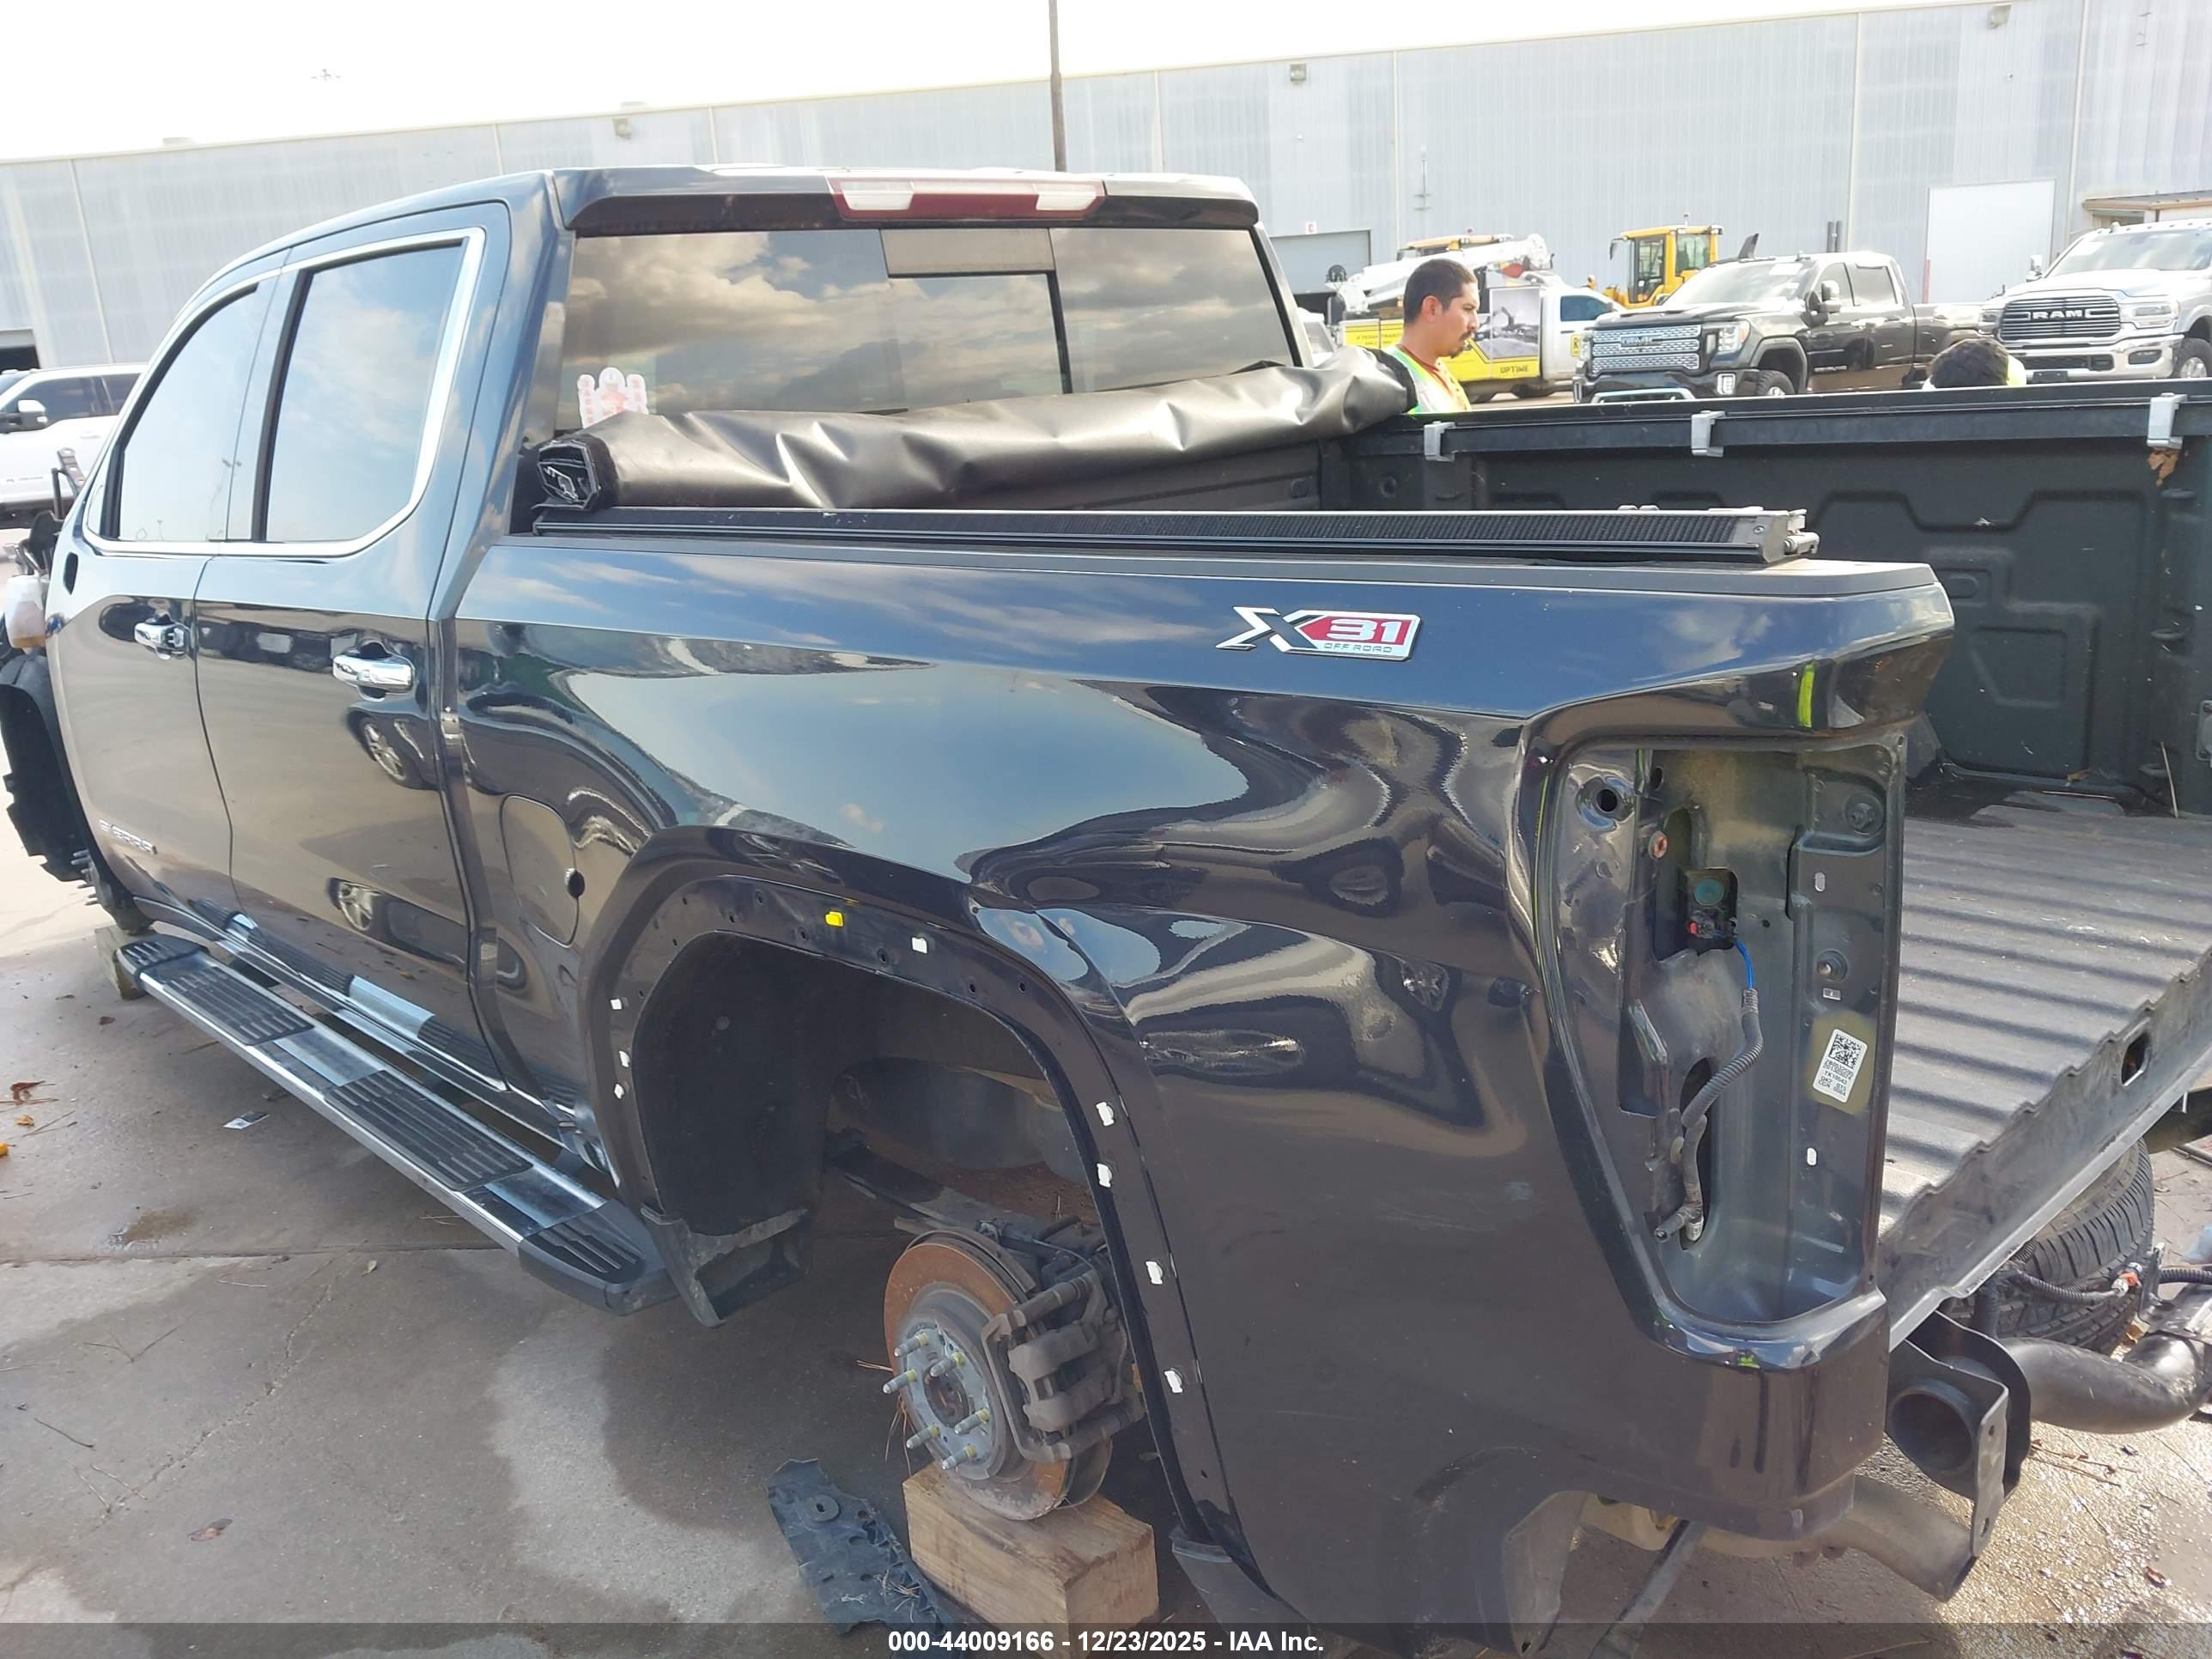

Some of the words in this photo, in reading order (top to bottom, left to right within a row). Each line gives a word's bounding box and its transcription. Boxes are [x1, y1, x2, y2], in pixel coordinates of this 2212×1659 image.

[2032, 309, 2082, 319] RAM
[1499, 365, 1528, 374] UPTIME
[1215, 605, 1403, 653] X31
[1352, 645, 1394, 653] ROAD
